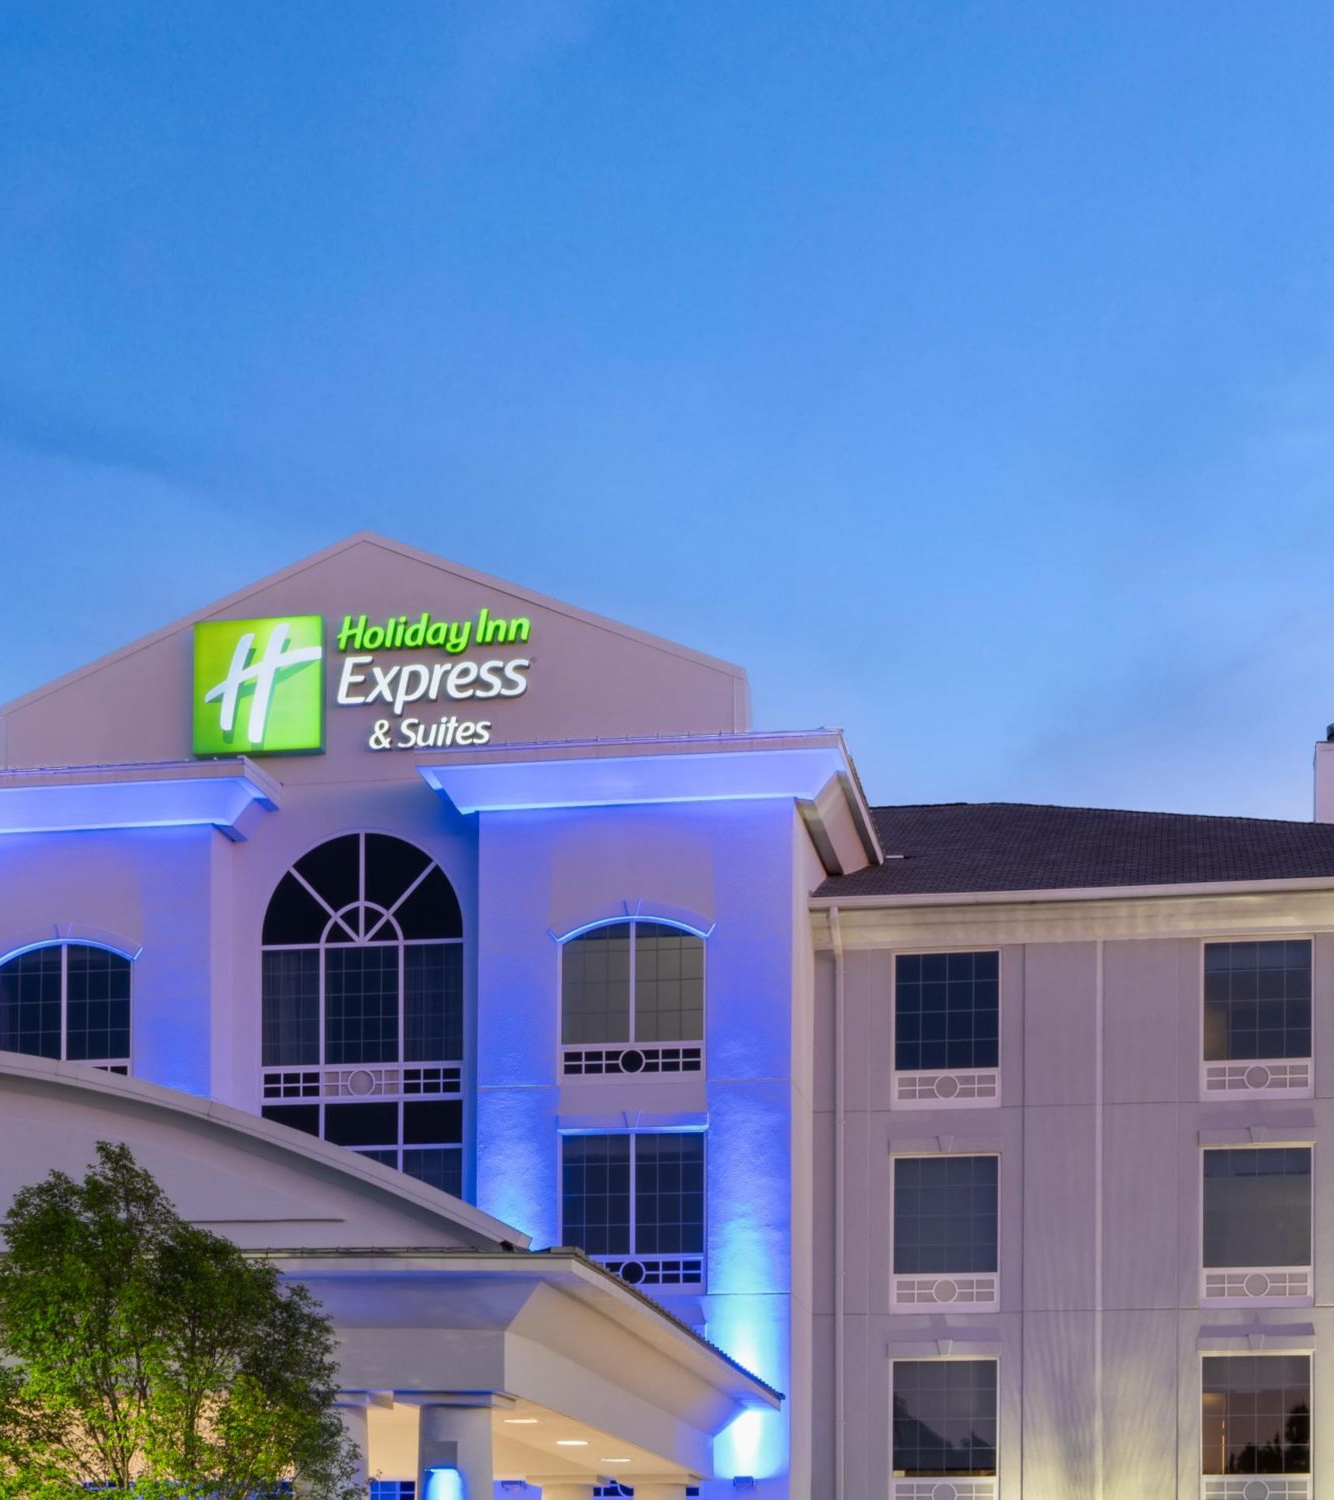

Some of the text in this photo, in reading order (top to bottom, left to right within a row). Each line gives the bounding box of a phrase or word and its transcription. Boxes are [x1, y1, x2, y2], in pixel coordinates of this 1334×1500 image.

[336, 608, 531, 653] Holiday Inn
[204, 622, 322, 744] H
[337, 654, 530, 715] Express
[369, 716, 491, 749] & Suites
